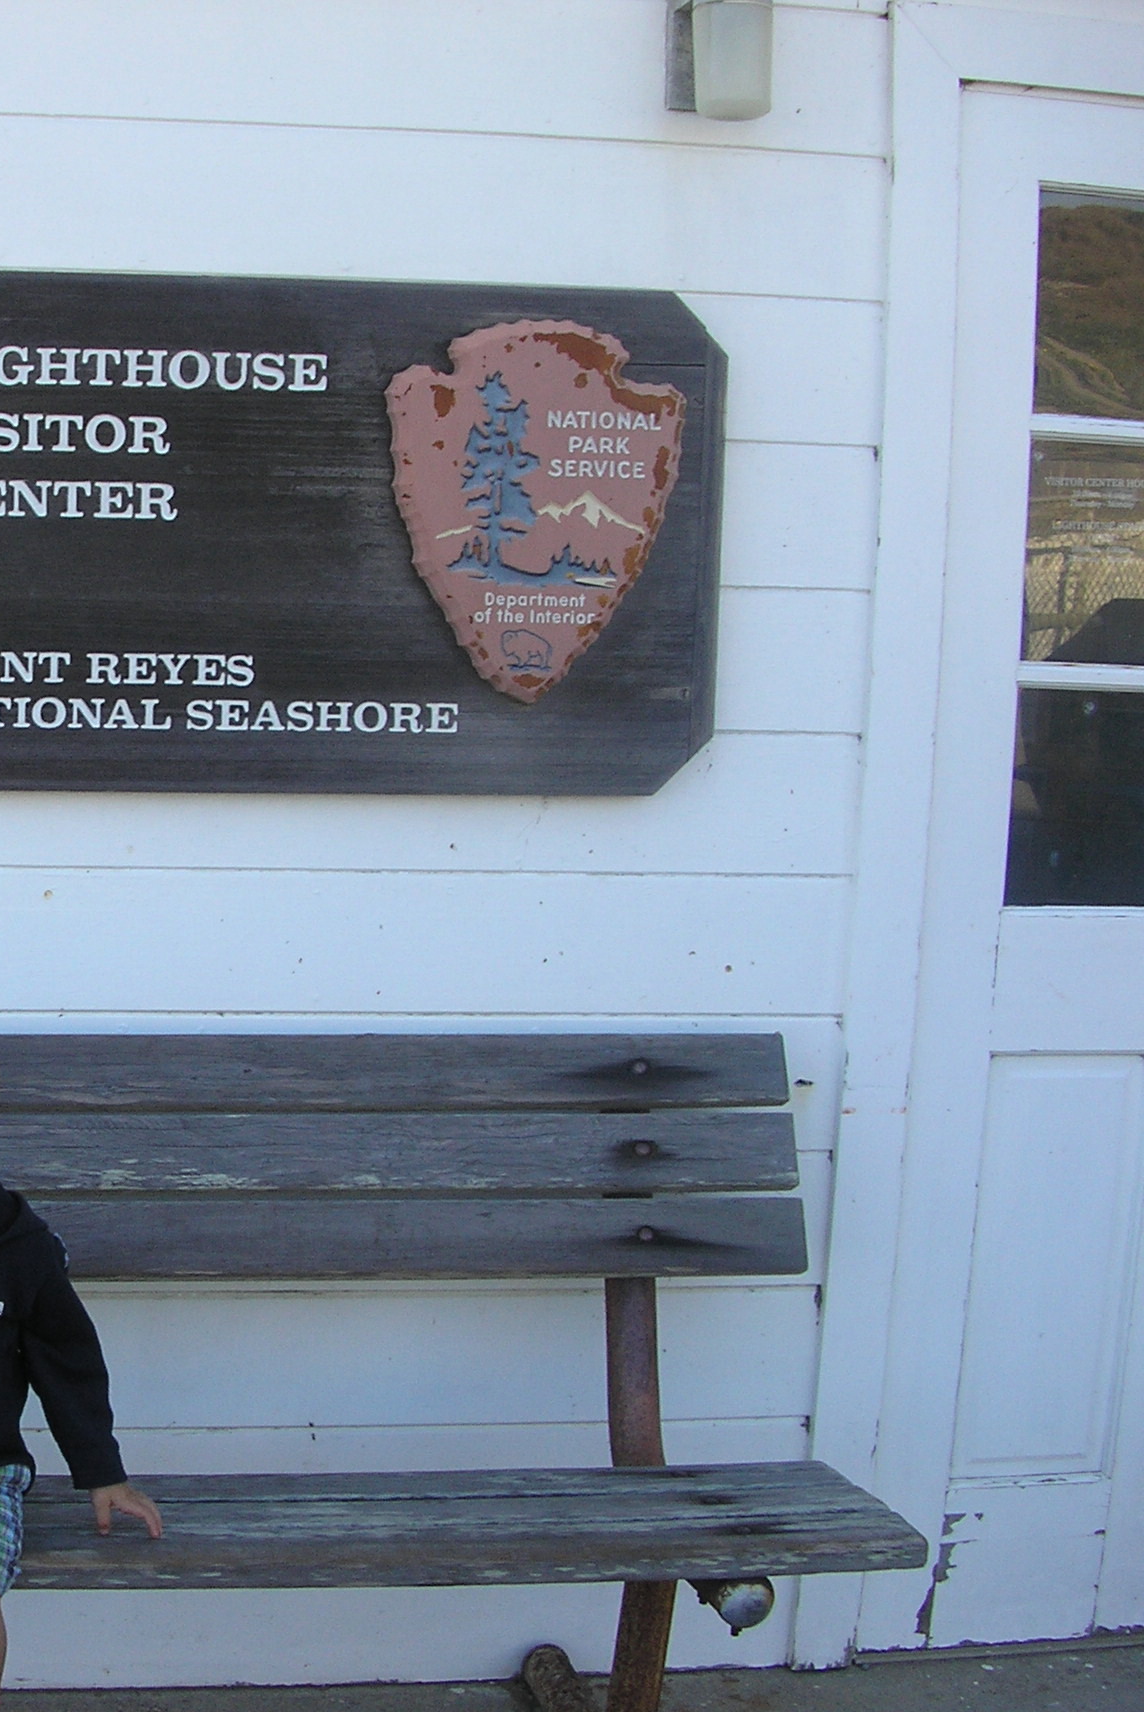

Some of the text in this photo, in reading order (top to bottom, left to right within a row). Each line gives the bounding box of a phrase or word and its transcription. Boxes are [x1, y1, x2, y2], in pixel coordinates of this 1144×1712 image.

[547, 410, 662, 431] NATIONAL
[569, 436, 631, 455] PARK
[548, 459, 647, 480] SERVICE
[1085, 477, 1124, 487] CENTER
[485, 592, 586, 609] Department
[473, 607, 596, 625] of the Interior
[85, 653, 256, 688] REYES
[186, 699, 460, 735] SEASHORE
